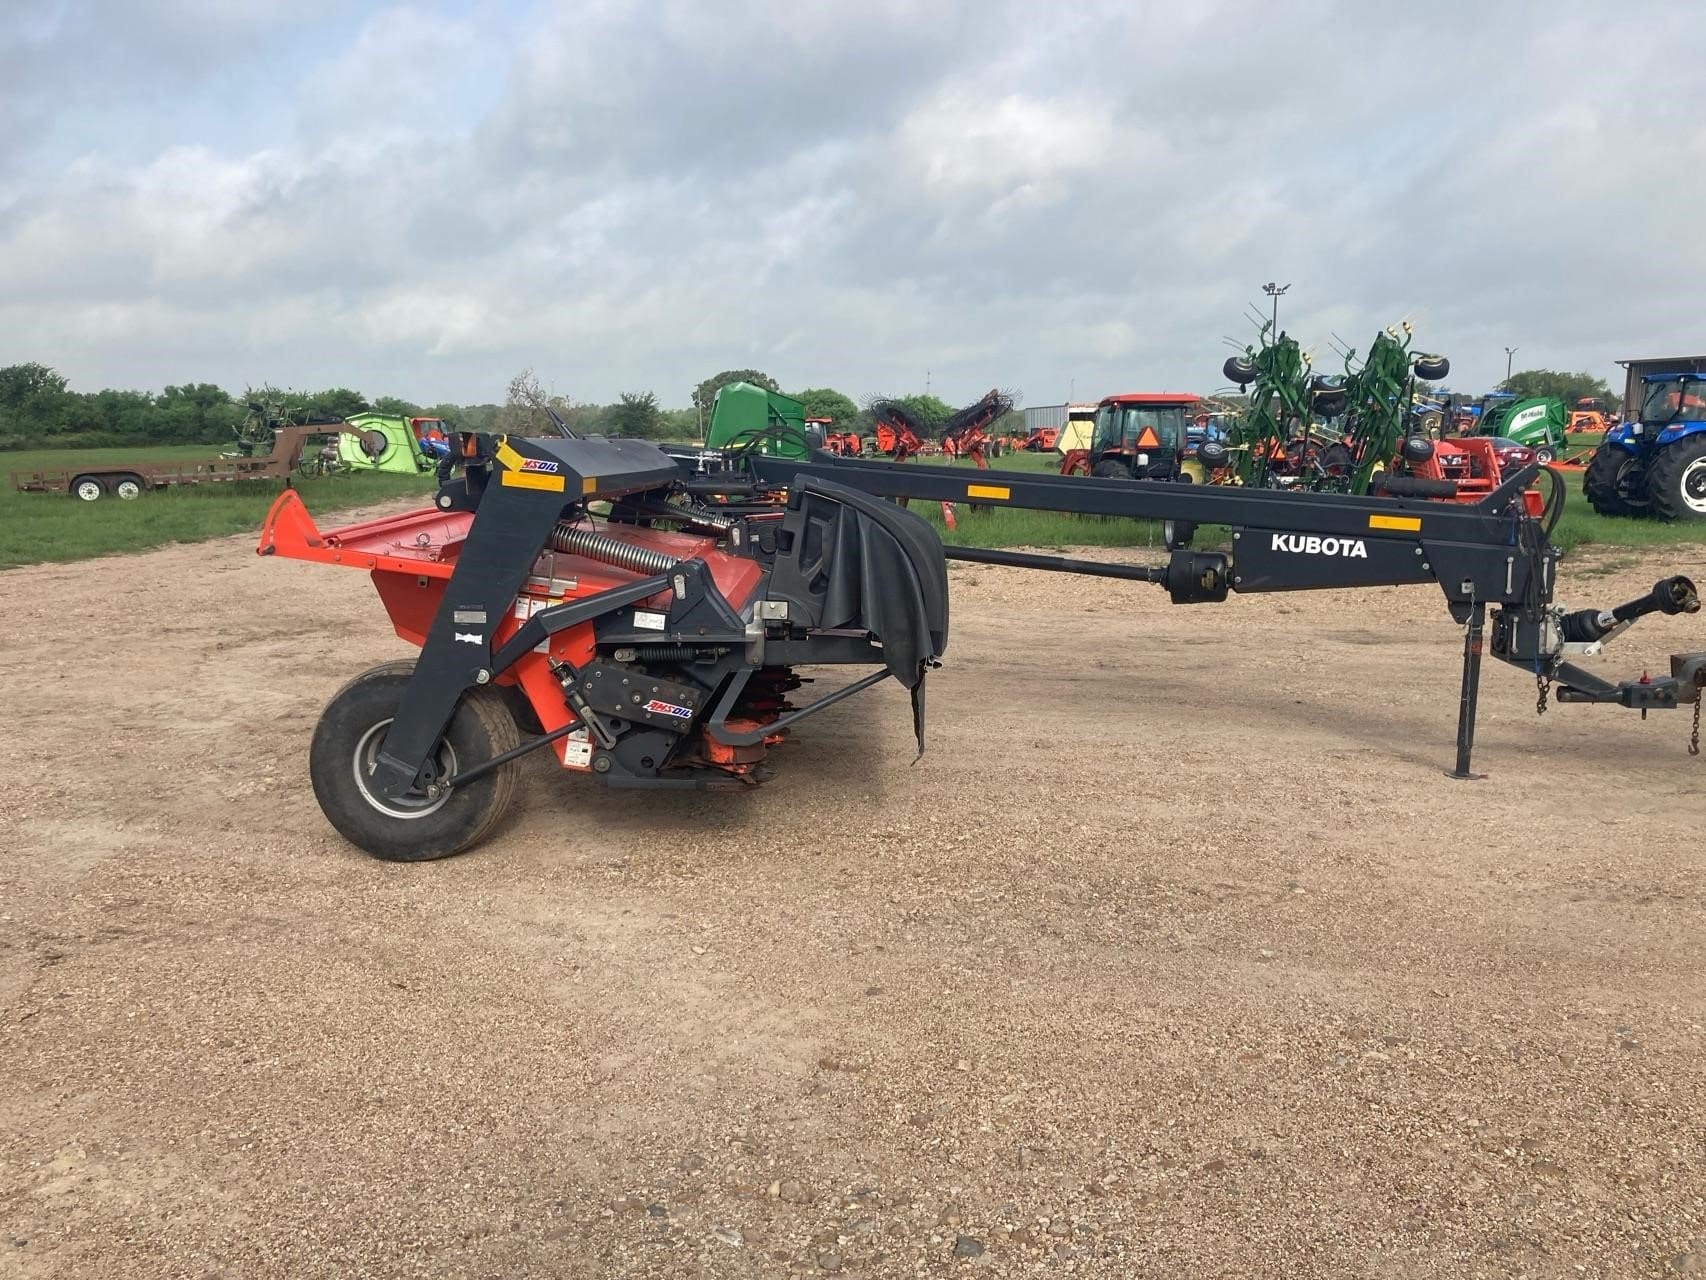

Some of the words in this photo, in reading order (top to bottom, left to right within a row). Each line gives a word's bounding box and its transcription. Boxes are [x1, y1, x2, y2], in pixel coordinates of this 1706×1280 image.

[522, 459, 558, 472] MSOIL
[1271, 534, 1368, 558] KUBOTA
[646, 701, 692, 717] AMSOIL
